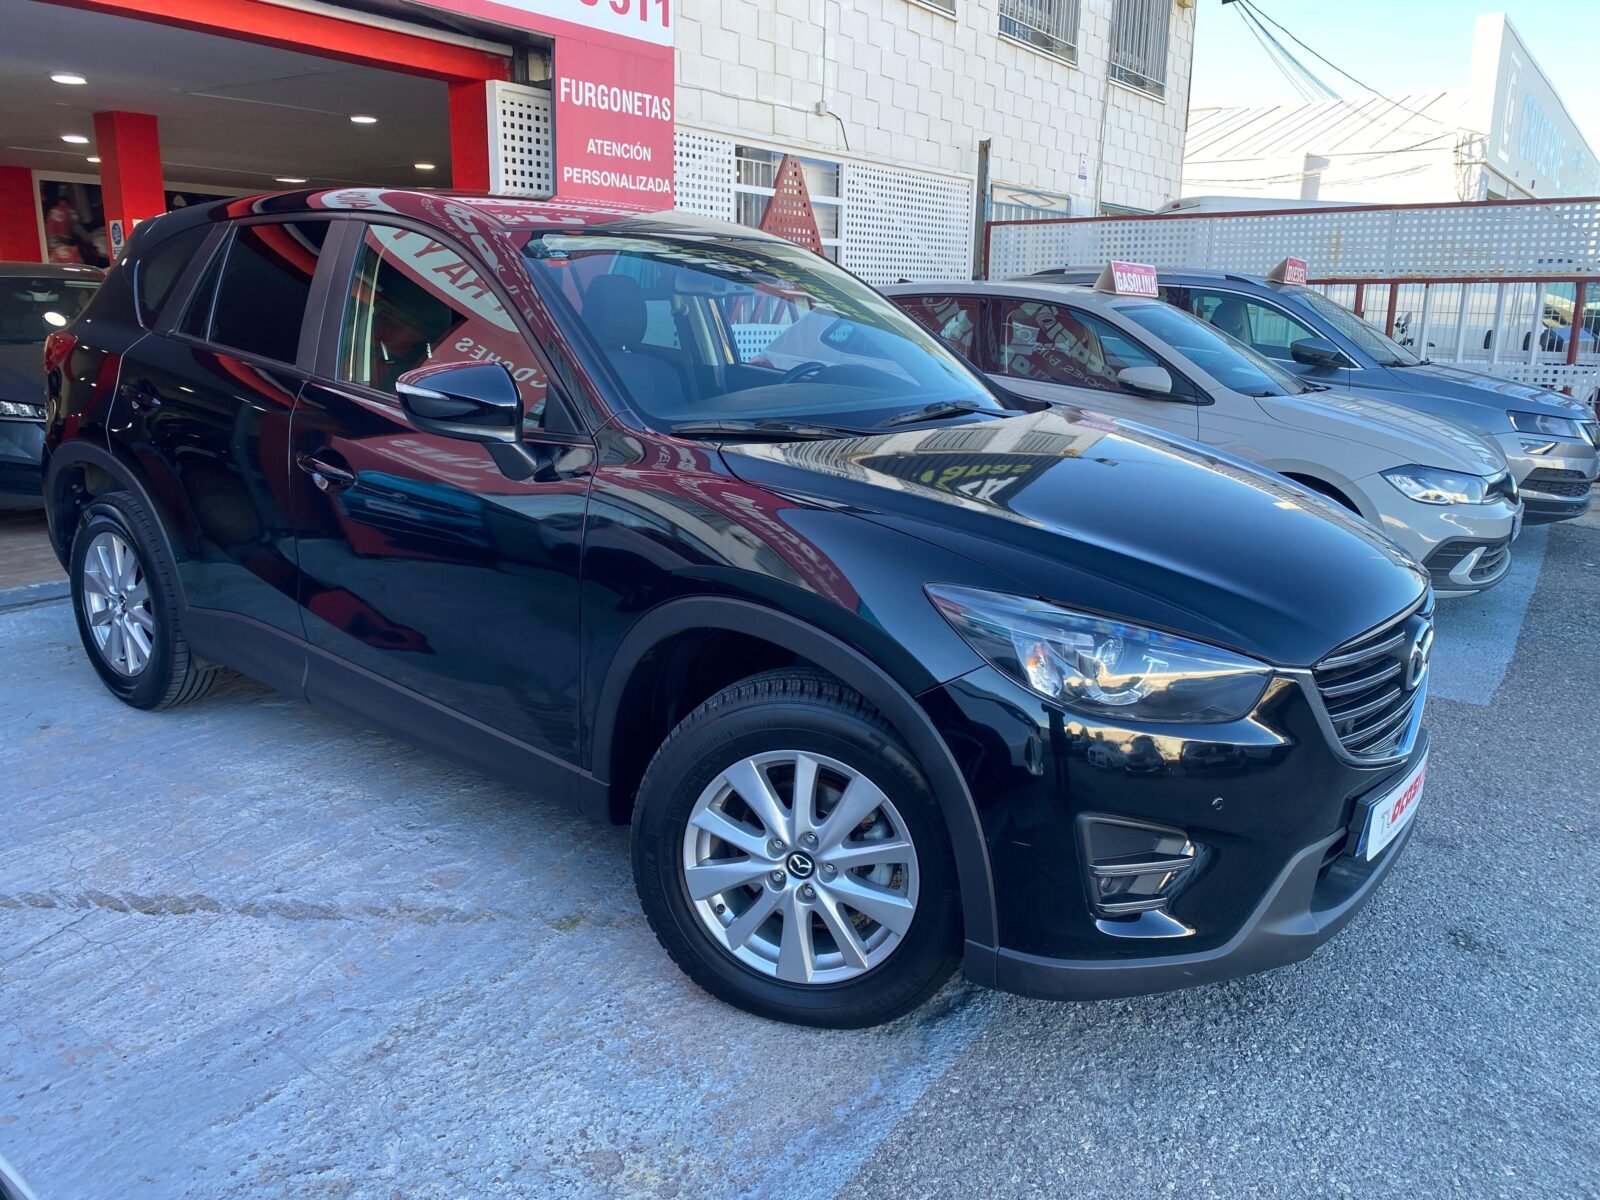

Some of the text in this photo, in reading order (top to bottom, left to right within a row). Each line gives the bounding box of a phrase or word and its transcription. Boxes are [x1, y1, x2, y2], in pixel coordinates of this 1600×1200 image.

[560, 76, 671, 122] FURGONETAS
[586, 138, 652, 161] ATENCIÓN
[563, 166, 672, 194] PERSONALIZADA
[1115, 270, 1158, 295] GASOLINA
[1286, 264, 1306, 283] DIESEL
